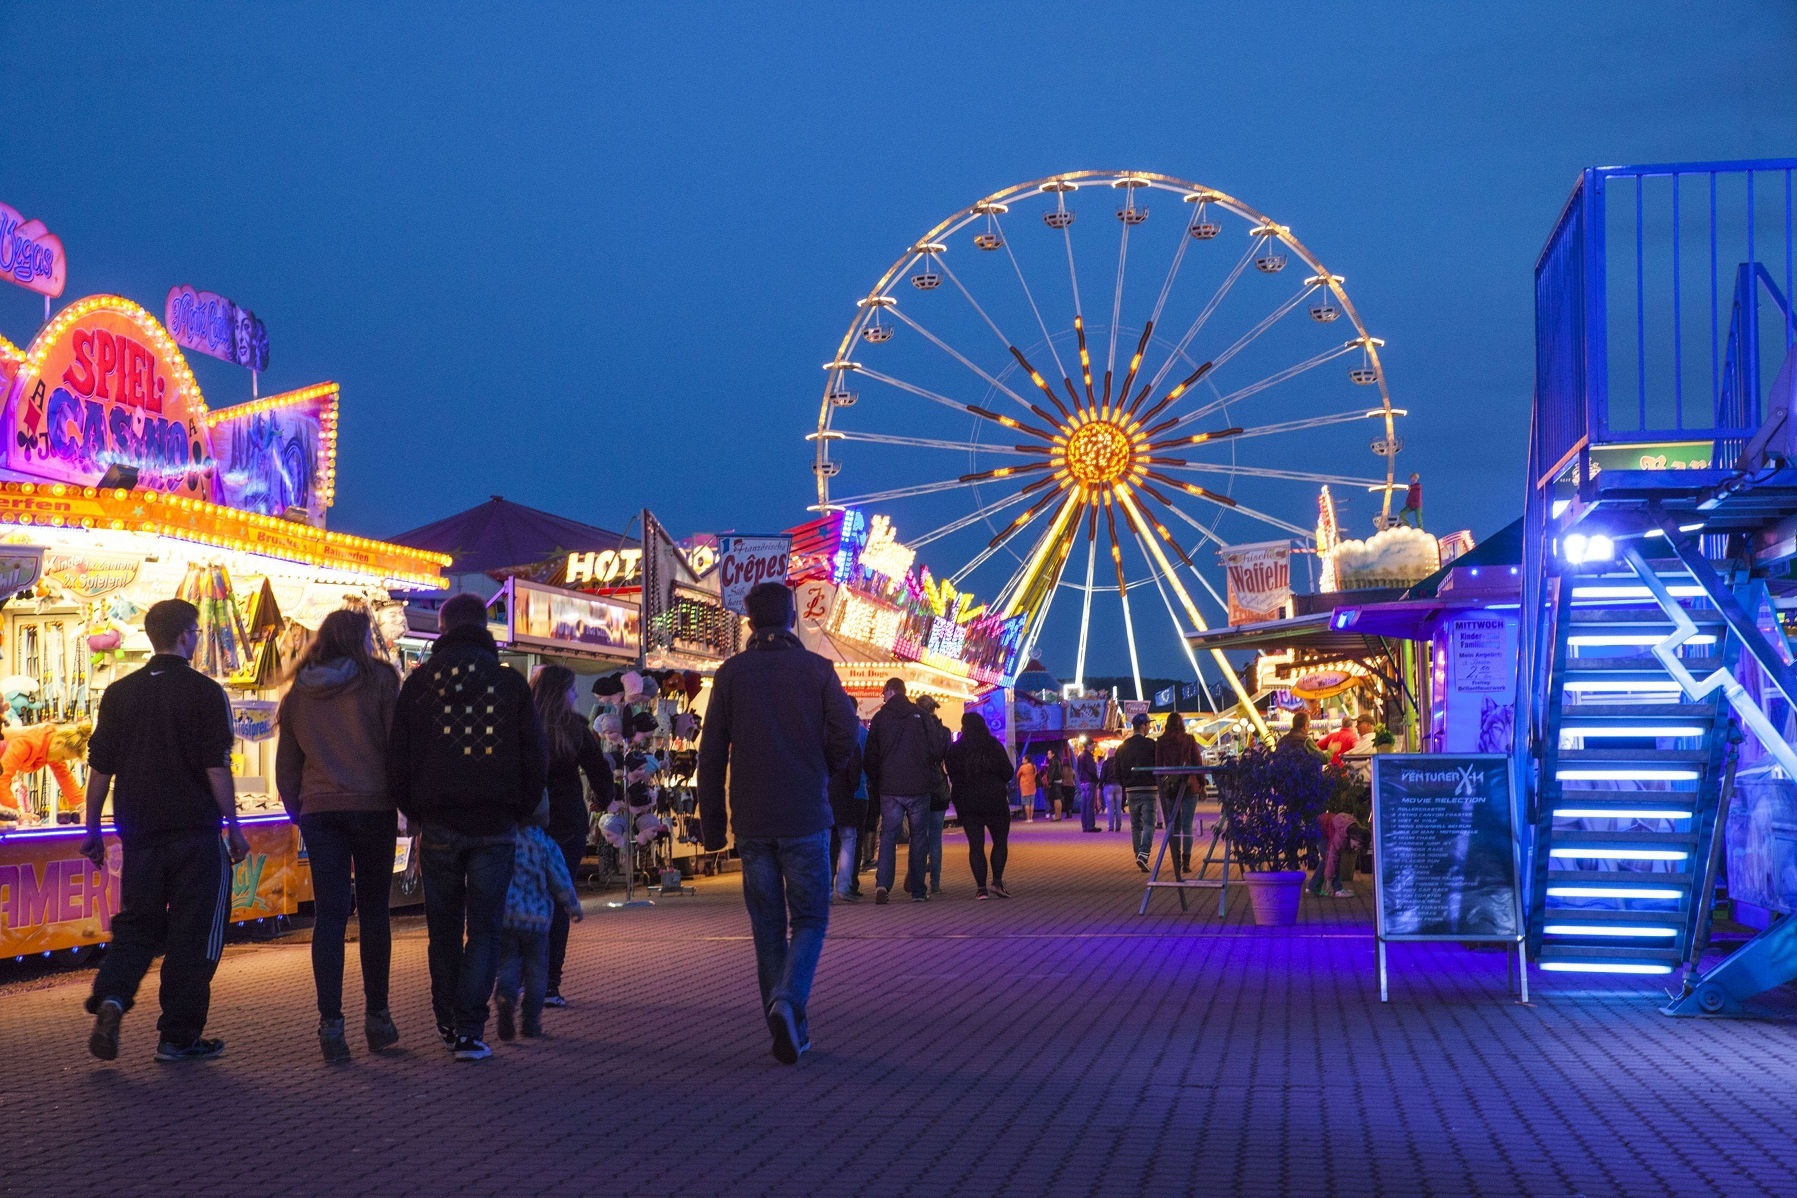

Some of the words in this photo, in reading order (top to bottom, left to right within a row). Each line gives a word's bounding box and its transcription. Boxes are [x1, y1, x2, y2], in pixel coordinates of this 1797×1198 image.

[565, 549, 643, 584] HOT
[721, 553, 788, 588] Crêpes
[1227, 560, 1289, 594] Waffeln
[1455, 621, 1504, 630] MITTWOCH
[849, 669, 865, 678] Hot
[867, 669, 889, 679] Dogs
